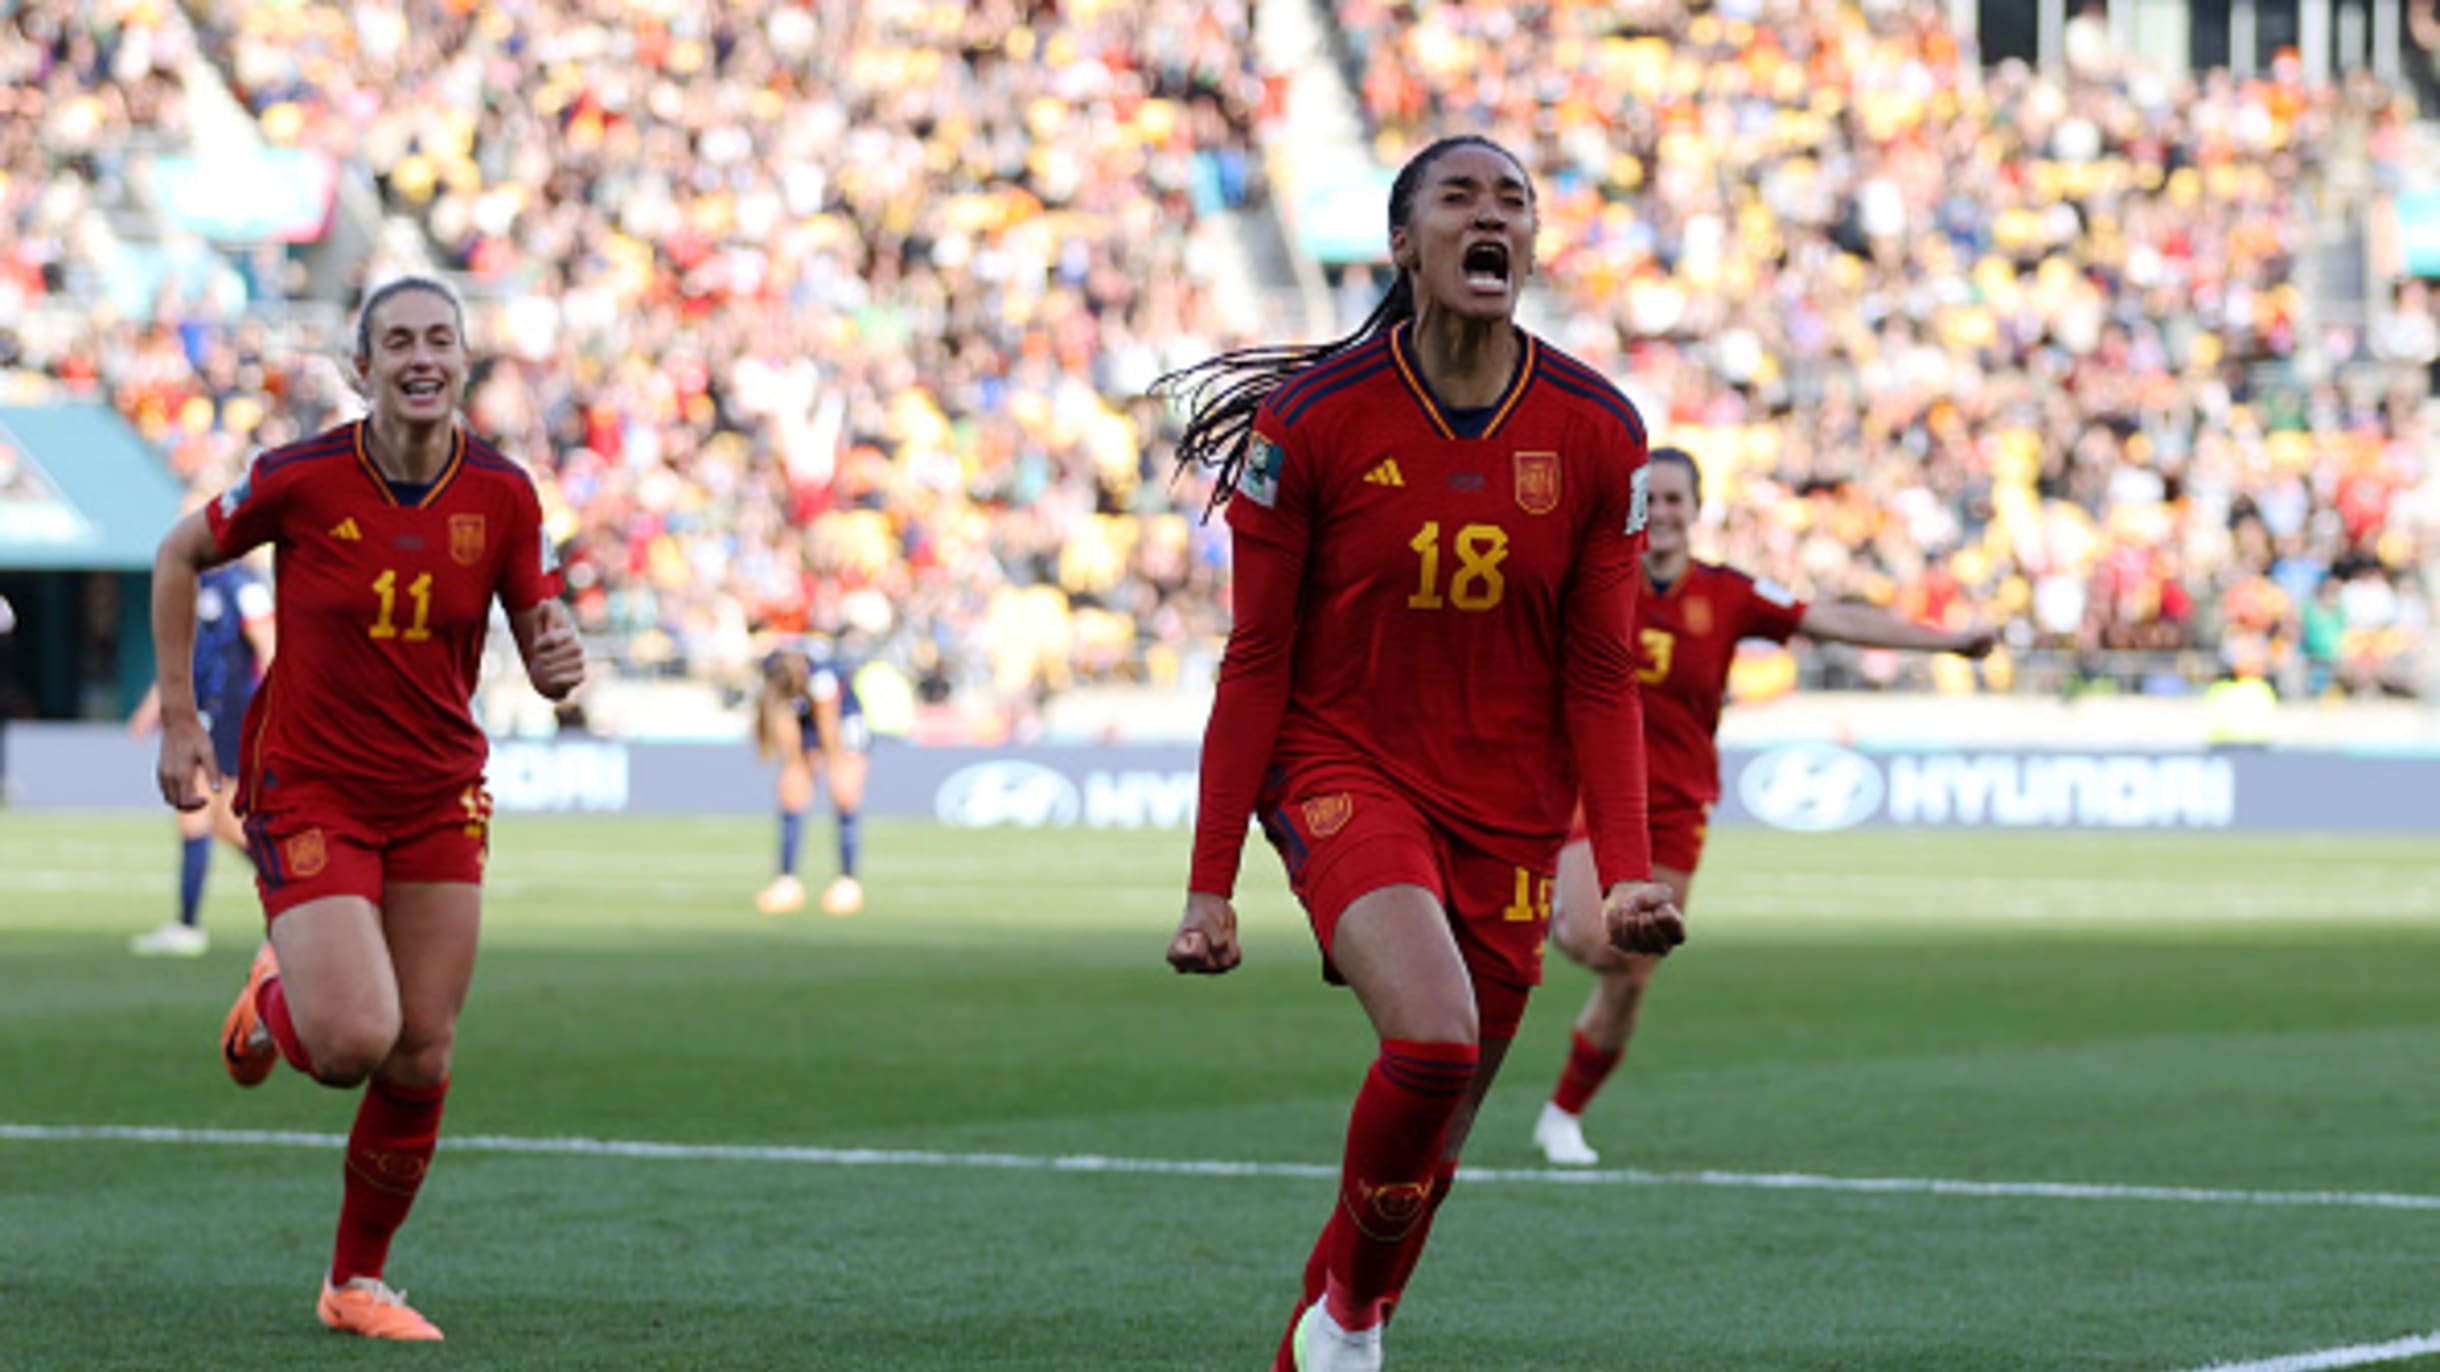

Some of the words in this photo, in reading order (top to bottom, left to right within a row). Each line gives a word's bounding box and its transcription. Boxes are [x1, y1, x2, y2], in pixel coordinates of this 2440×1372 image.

[1408, 521, 1508, 610] 18
[369, 569, 433, 639] 11
[1635, 628, 1674, 684] 3
[1084, 770, 1200, 829] HY
[1889, 757, 2235, 826] HYUNDAI
